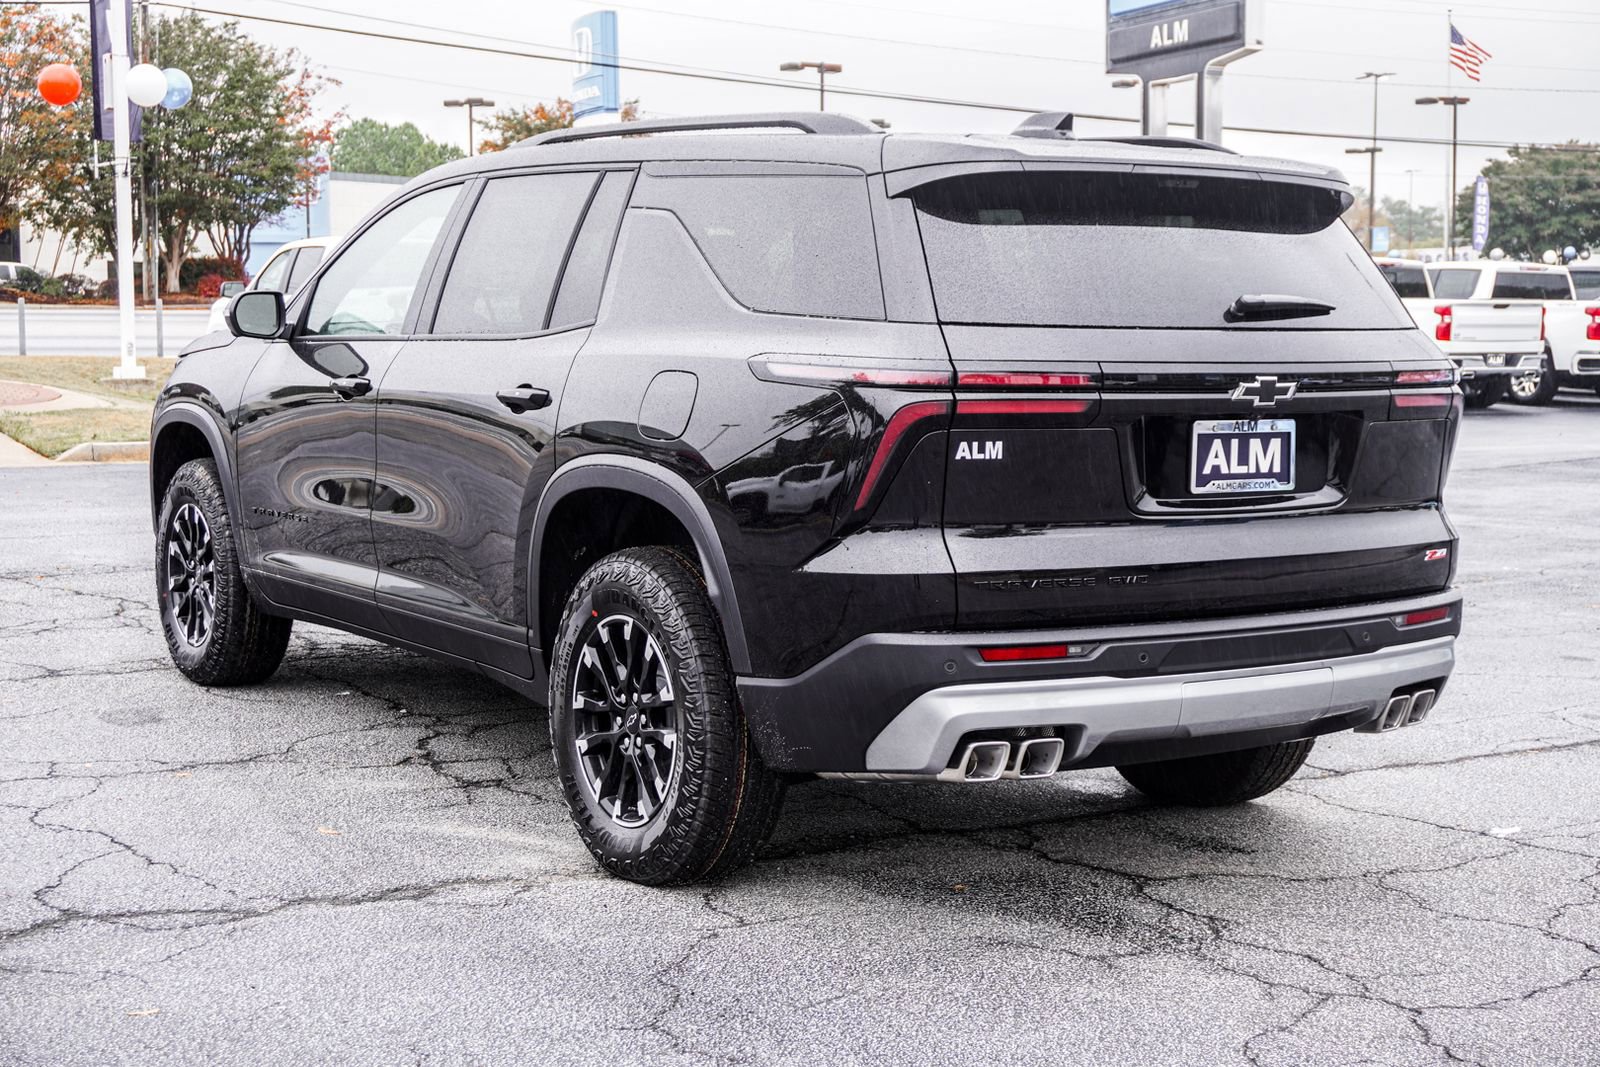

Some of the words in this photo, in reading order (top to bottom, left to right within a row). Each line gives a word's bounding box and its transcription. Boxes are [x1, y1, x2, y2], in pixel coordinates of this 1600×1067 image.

[1151, 19, 1189, 49] ALM
[1233, 421, 1258, 432] ALM
[955, 441, 1003, 460] ALM
[1202, 438, 1281, 474] ALM
[1216, 480, 1271, 490] ALMCARS.COM
[974, 576, 1096, 590] TRAVERSE
